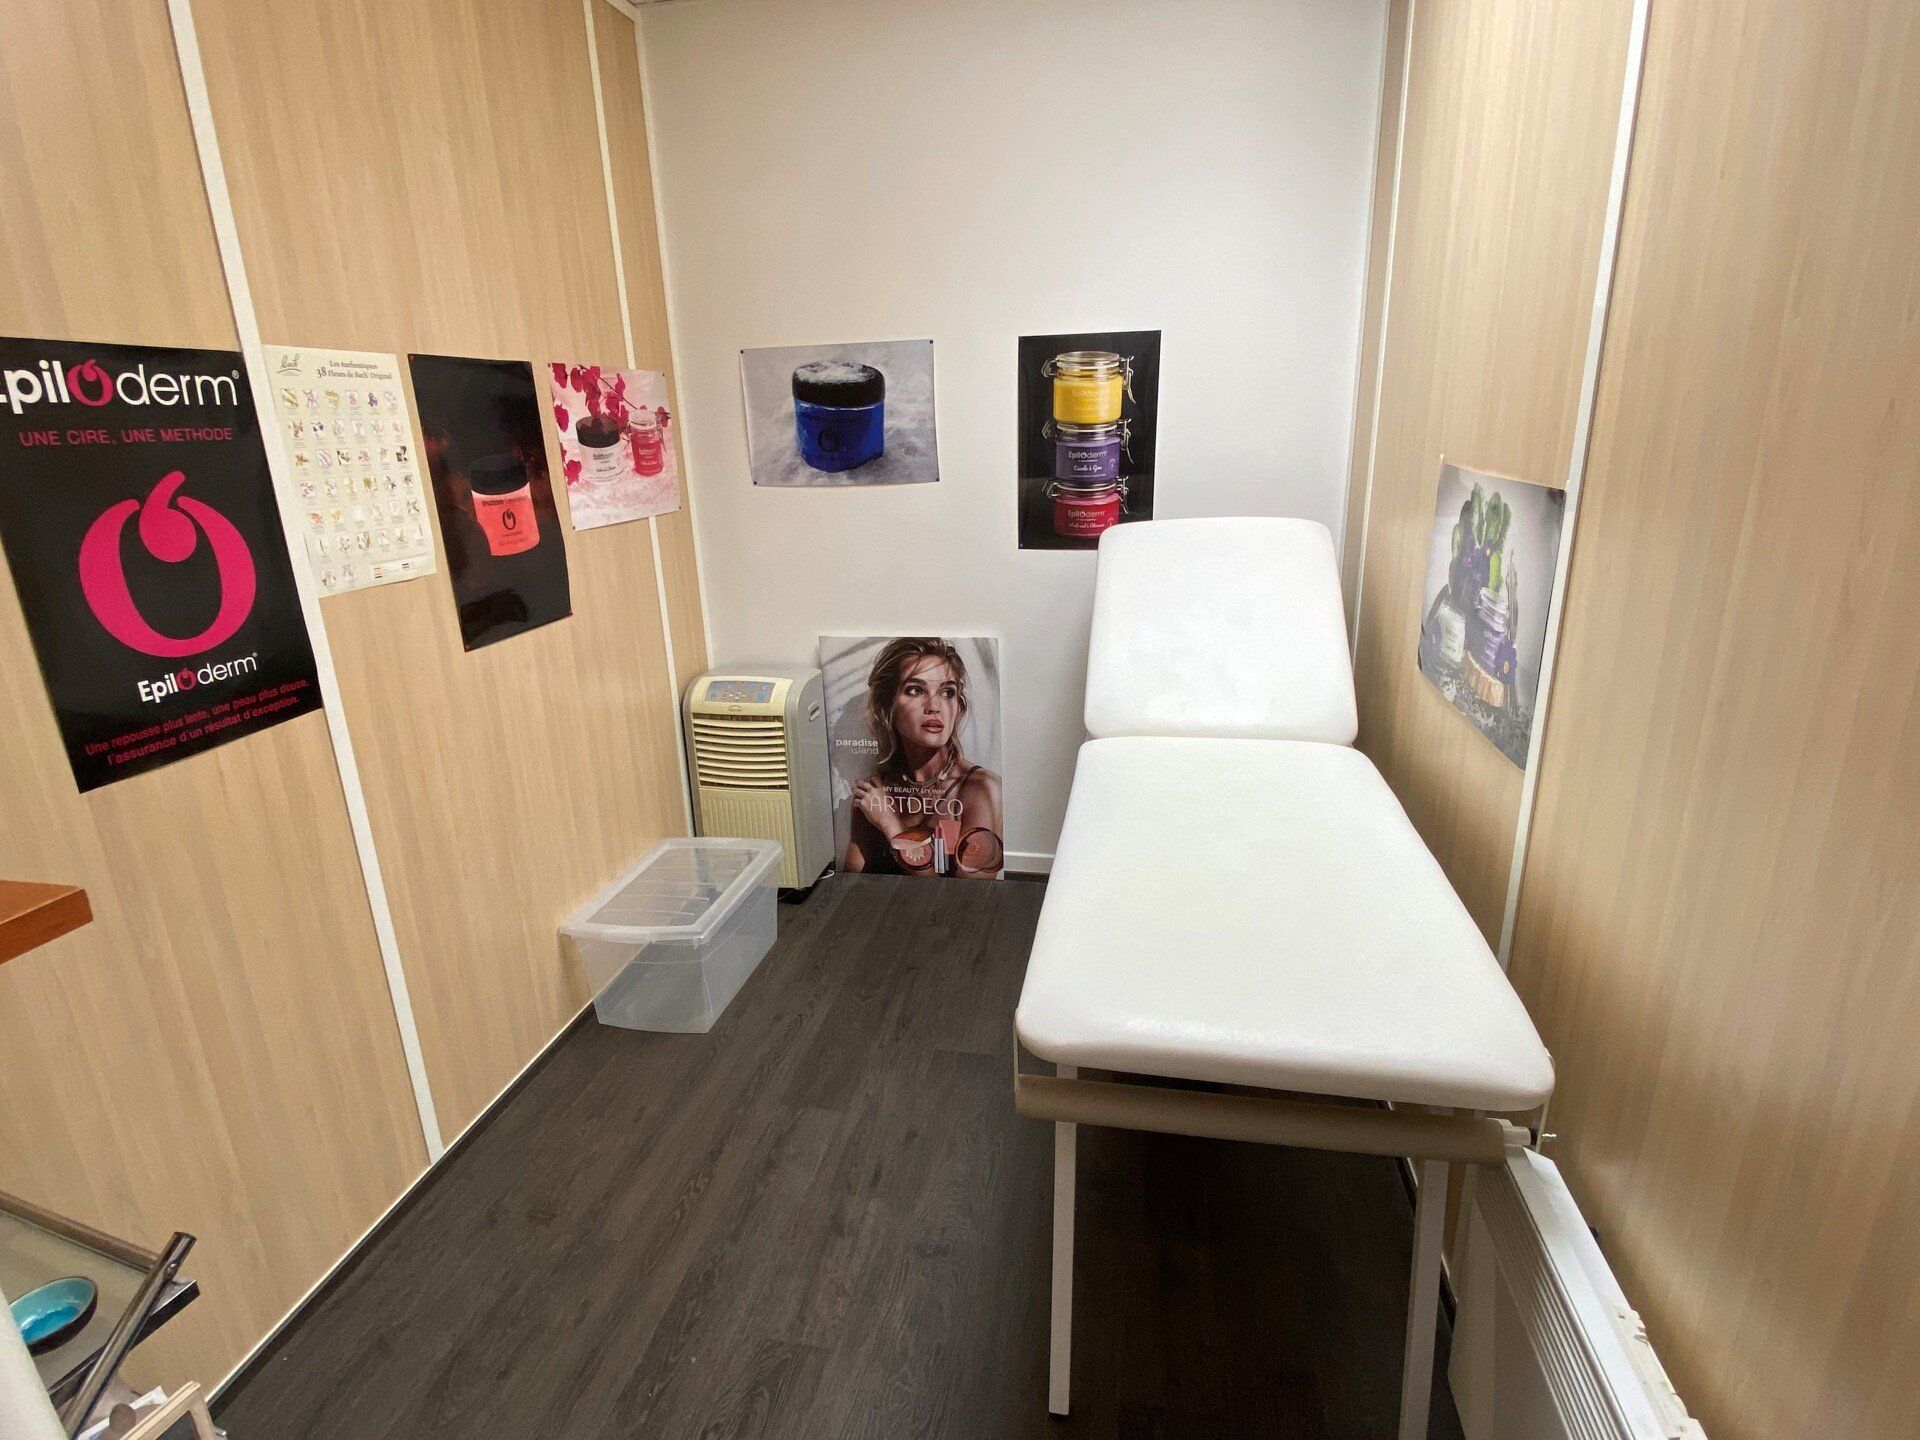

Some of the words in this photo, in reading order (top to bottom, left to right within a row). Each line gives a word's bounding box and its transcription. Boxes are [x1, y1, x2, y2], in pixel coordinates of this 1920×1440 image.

[316, 366, 327, 378] 38
[346, 370, 354, 378] de
[19, 430, 61, 447] UNE
[66, 429, 117, 446] CIRE,
[120, 429, 154, 443] UNE
[160, 427, 234, 442] METHODE
[85, 741, 109, 755] Une
[111, 725, 161, 748] repousse
[163, 718, 184, 734] plus
[211, 702, 230, 715] une
[232, 694, 257, 710] peau
[258, 687, 278, 701] plus
[835, 738, 879, 747] paradise
[851, 746, 879, 755] island
[893, 786, 920, 794] BEAUTY
[870, 795, 964, 817] ARTDECO
